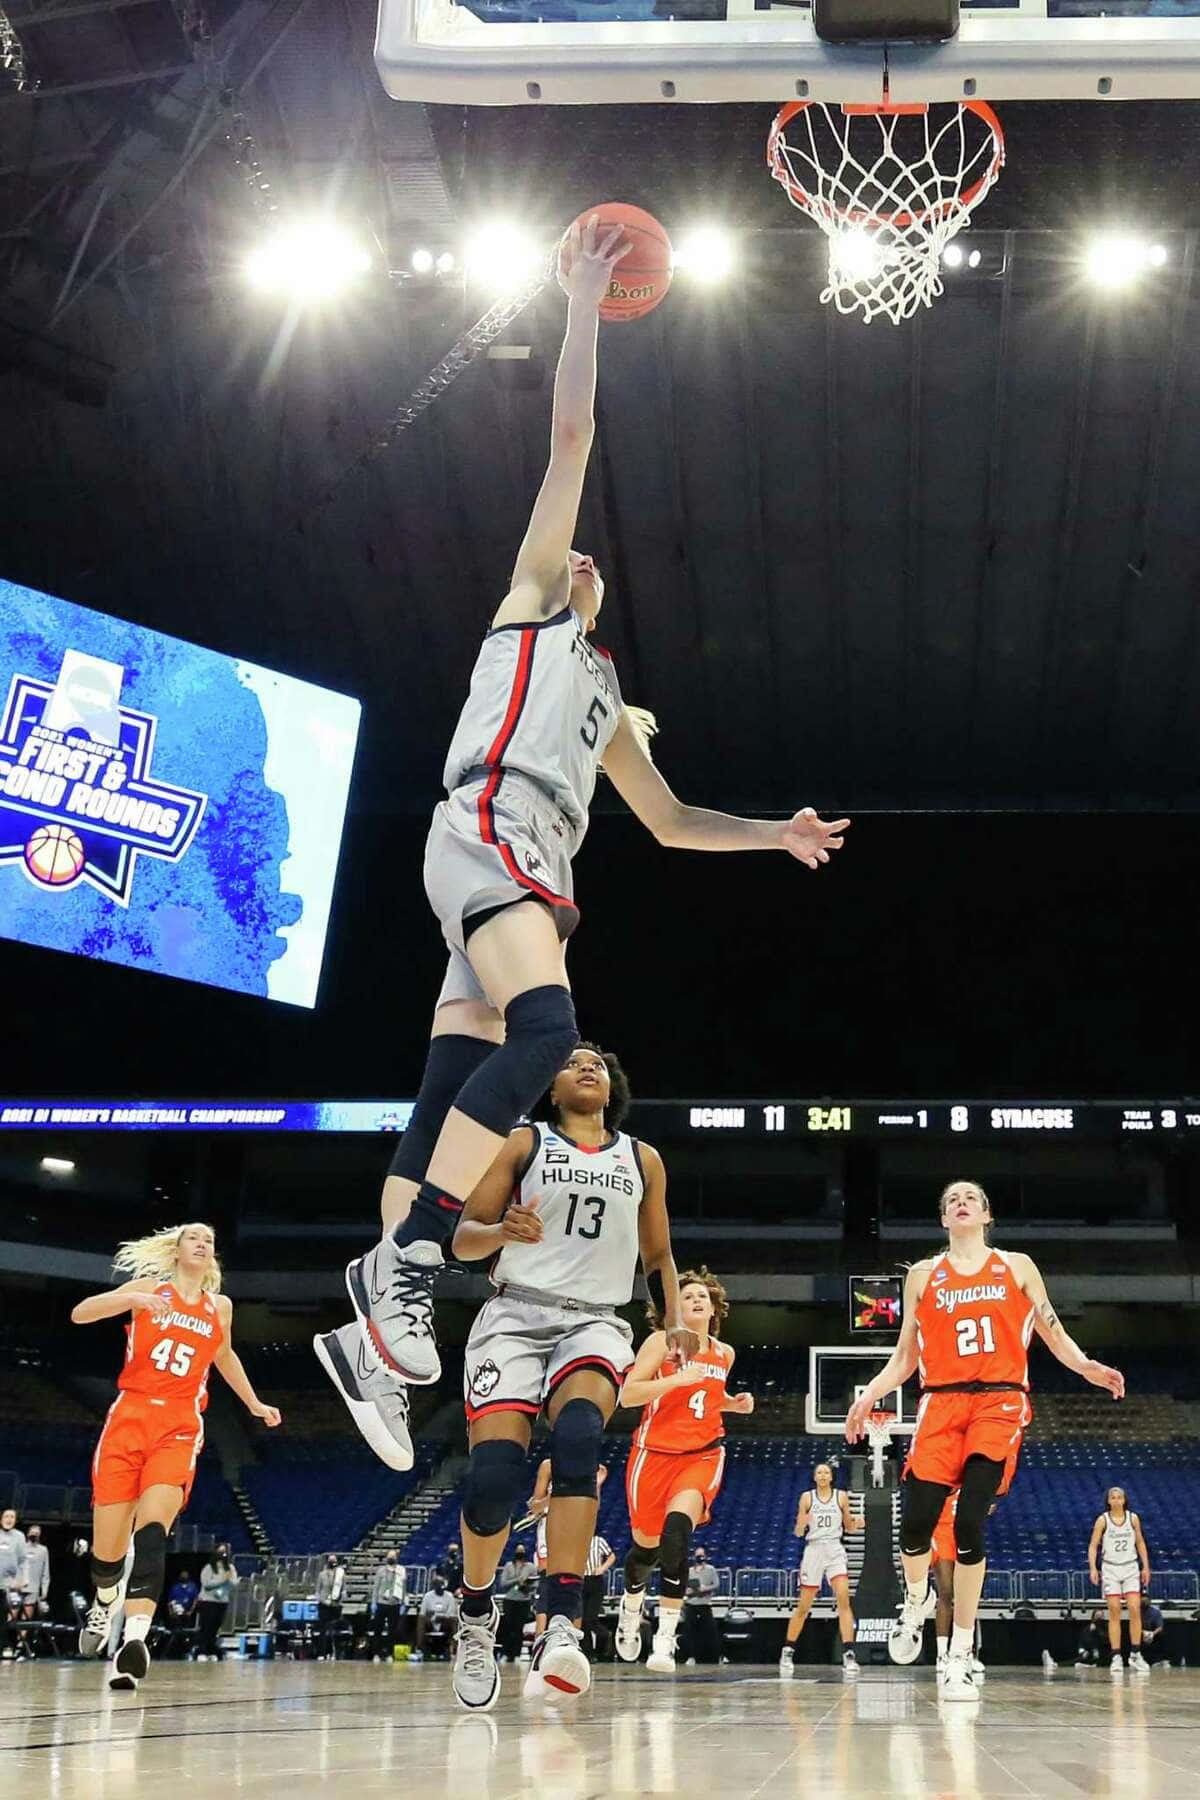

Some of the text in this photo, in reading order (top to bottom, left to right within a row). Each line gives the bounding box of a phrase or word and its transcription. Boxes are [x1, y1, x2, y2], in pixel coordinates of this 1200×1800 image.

[604, 279, 655, 300] lson
[580, 696, 608, 750] 5
[18, 735, 127, 791] FIRST &
[65, 782, 181, 838] ROUNDS
[111, 1108, 187, 1123] BASKETBALL
[189, 1108, 286, 1123] CHAMPIONSHIP
[689, 1108, 745, 1128] UCONN
[763, 1105, 785, 1131] 11
[807, 1106, 851, 1131] 3:41
[917, 1109, 928, 1128] 1
[950, 1106, 969, 1132] 8
[991, 1108, 1073, 1129] SYRACUSE
[1160, 1109, 1177, 1129] 3
[1121, 1121, 1154, 1130] FOULS
[542, 1167, 634, 1196] HUSKIES
[564, 1192, 606, 1240] 13
[936, 1285, 1007, 1315] Syracuse
[152, 1309, 214, 1339] Syracuse
[954, 1316, 996, 1358] 21
[150, 1337, 196, 1378] 45
[687, 1388, 708, 1420] 4
[816, 1514, 833, 1529] 20
[1114, 1539, 1129, 1553] 22
[856, 1630, 892, 1643] BASKE
